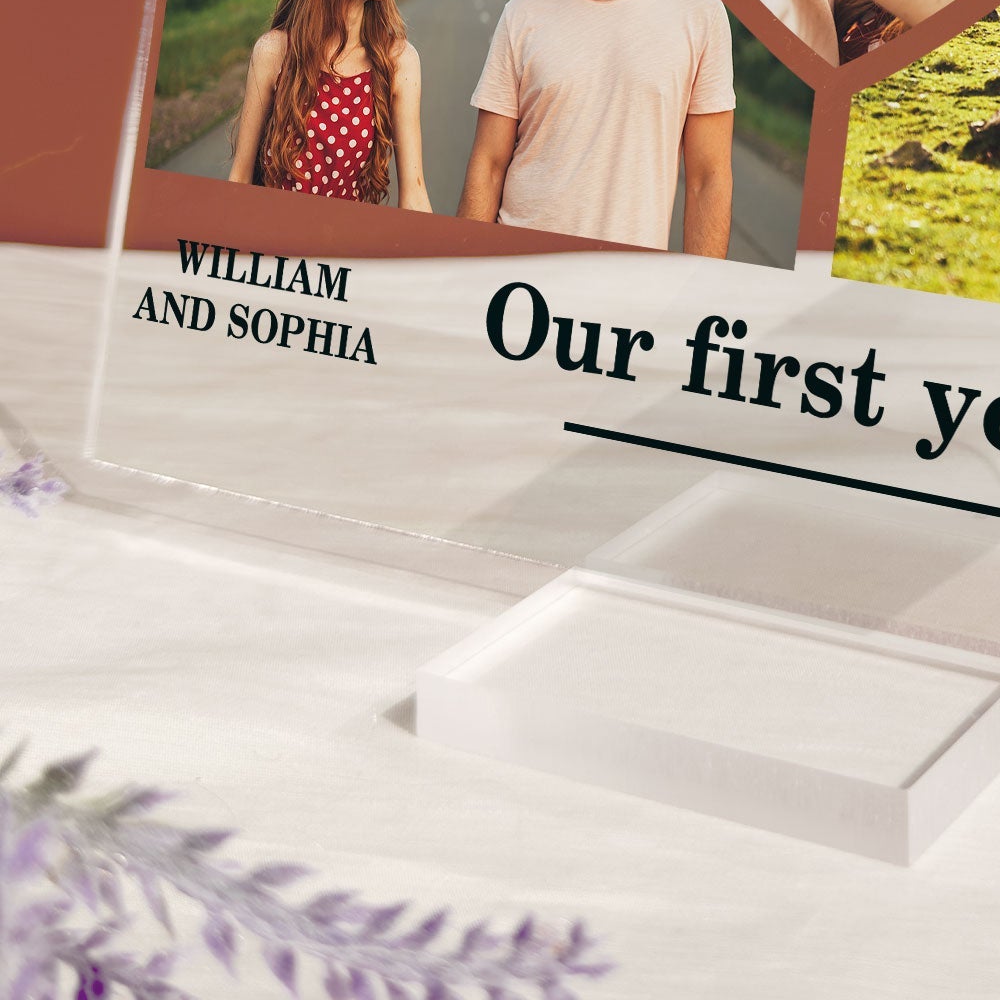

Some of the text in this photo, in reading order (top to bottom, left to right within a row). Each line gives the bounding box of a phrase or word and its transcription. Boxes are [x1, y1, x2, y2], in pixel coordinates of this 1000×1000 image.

[176, 238, 352, 303] WILLIAM
[132, 286, 378, 365] AND SOPHIA
[484, 281, 655, 382] Our
[681, 315, 886, 428] first
